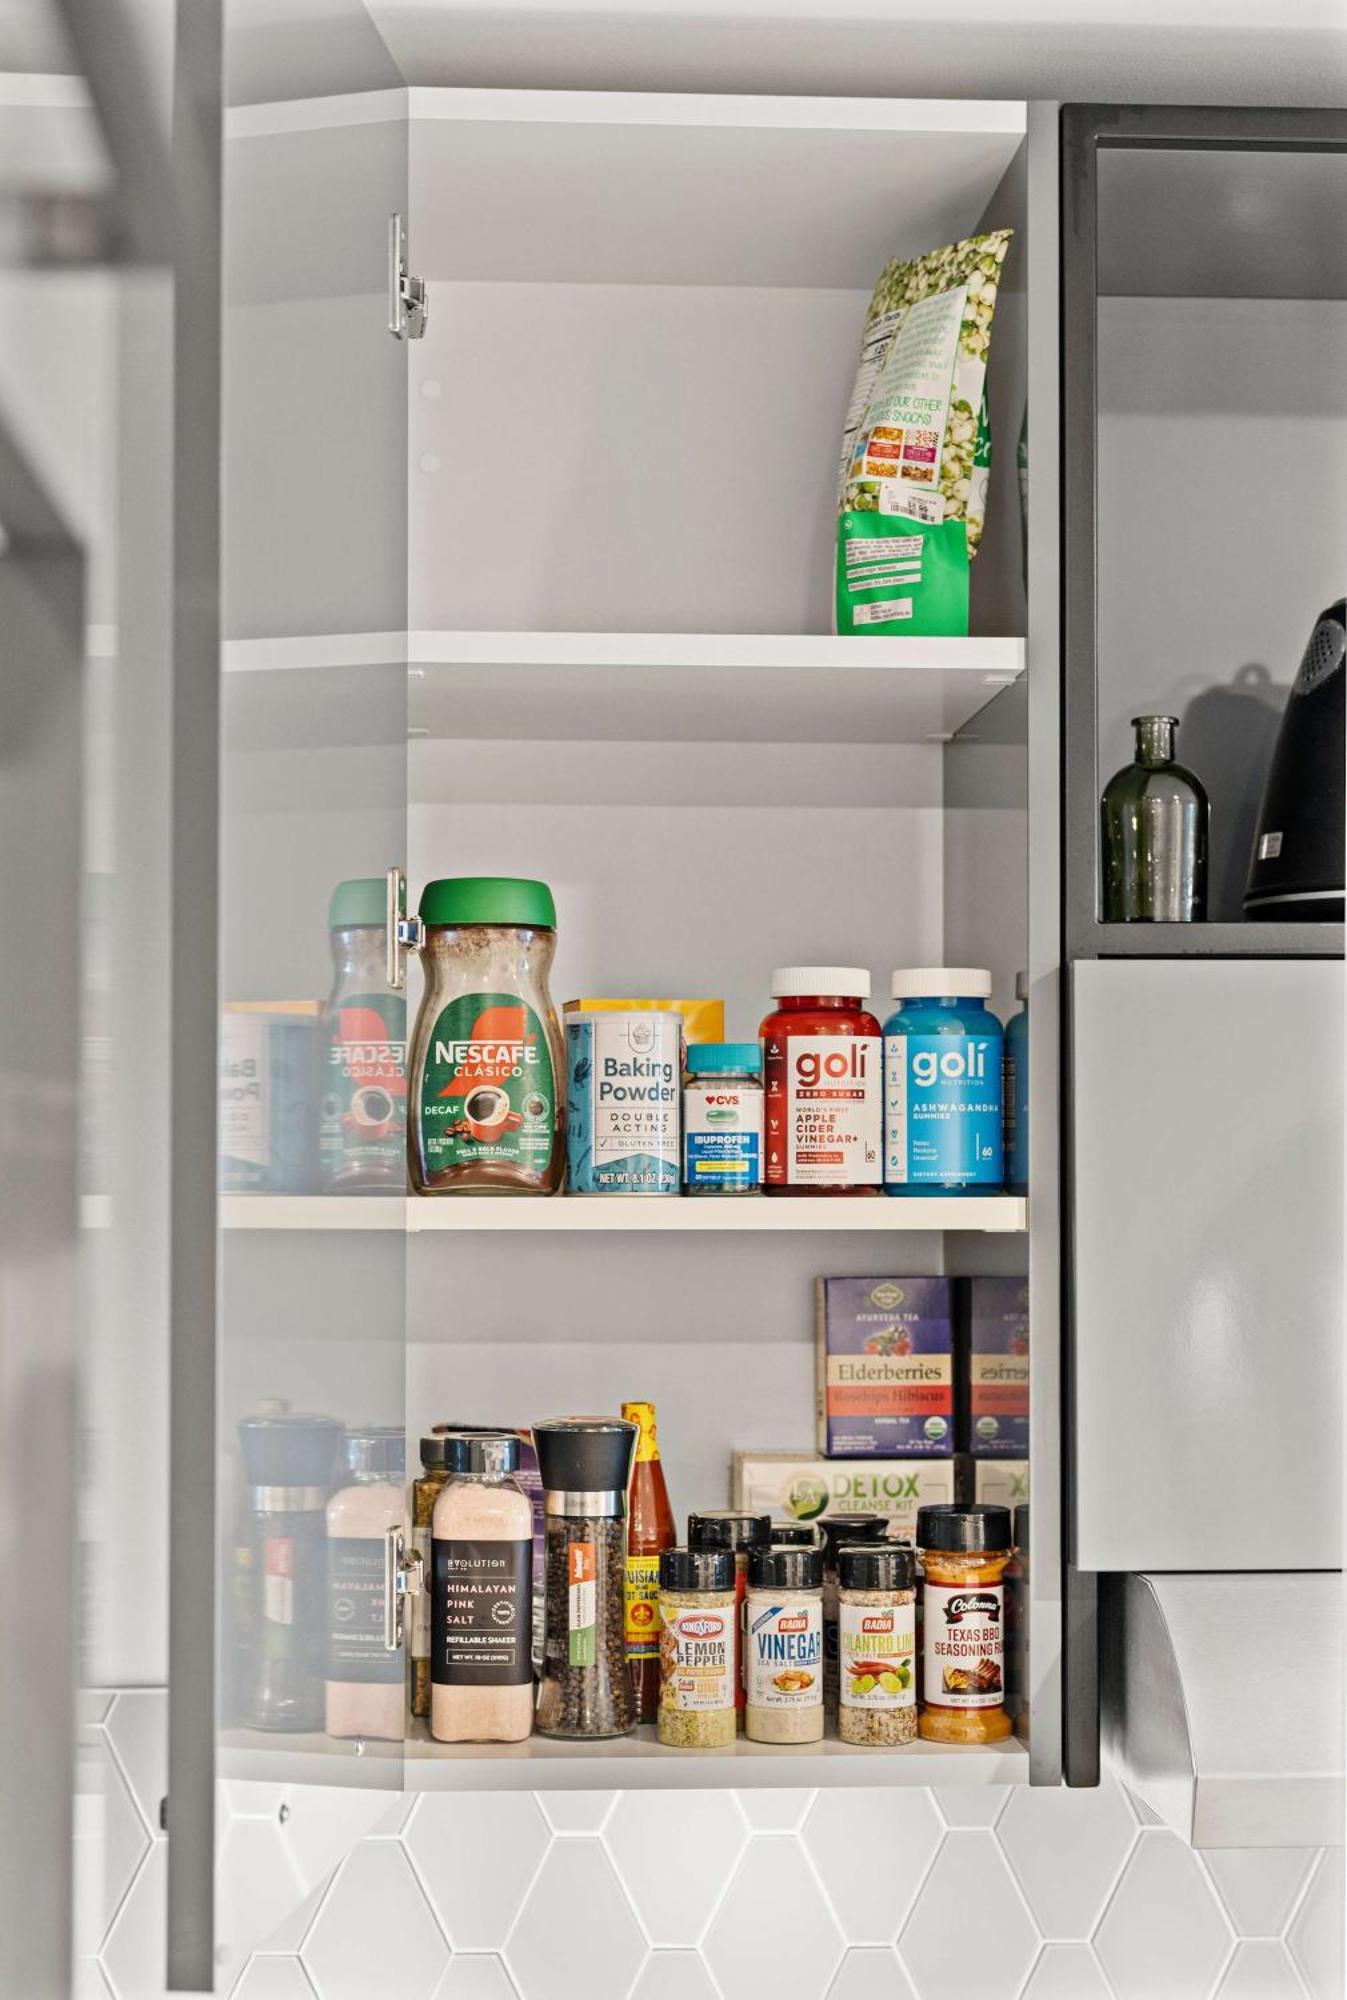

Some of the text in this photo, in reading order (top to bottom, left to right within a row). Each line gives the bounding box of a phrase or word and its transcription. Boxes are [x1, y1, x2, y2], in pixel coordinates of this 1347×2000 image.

[604, 1057, 673, 1082] Baking
[600, 1082, 676, 1101] Powder
[716, 1095, 739, 1105] CVS
[424, 1106, 460, 1115] DECAF
[913, 1103, 998, 1112] ASHWAGANDHA
[610, 1112, 669, 1121] DOUBLE
[796, 1114, 836, 1123] APPLE
[913, 1112, 951, 1120] GUMMIES
[612, 1124, 668, 1133] ACTING
[796, 1125, 835, 1133] CIDER
[982, 1146, 993, 1157] 60
[600, 1172, 614, 1184] NET
[903, 1312, 920, 1321] TEA
[839, 1364, 942, 1381] Elderberries
[892, 1389, 945, 1402] Hibiscus
[833, 1473, 919, 1498] DETOX
[838, 1500, 913, 1511] CLEANSE KIT
[448, 1584, 516, 1593] HIMALAYAN
[447, 1600, 475, 1609] PINK
[446, 1615, 475, 1625] SALT
[863, 1619, 892, 1631] BADIA
[446, 1635, 487, 1643] REFILLABLE
[947, 1628, 980, 1642] TEXAS
[677, 1642, 726, 1656] LEMON
[934, 1642, 993, 1657] SEASONING
[677, 1655, 726, 1667] PEPPER
